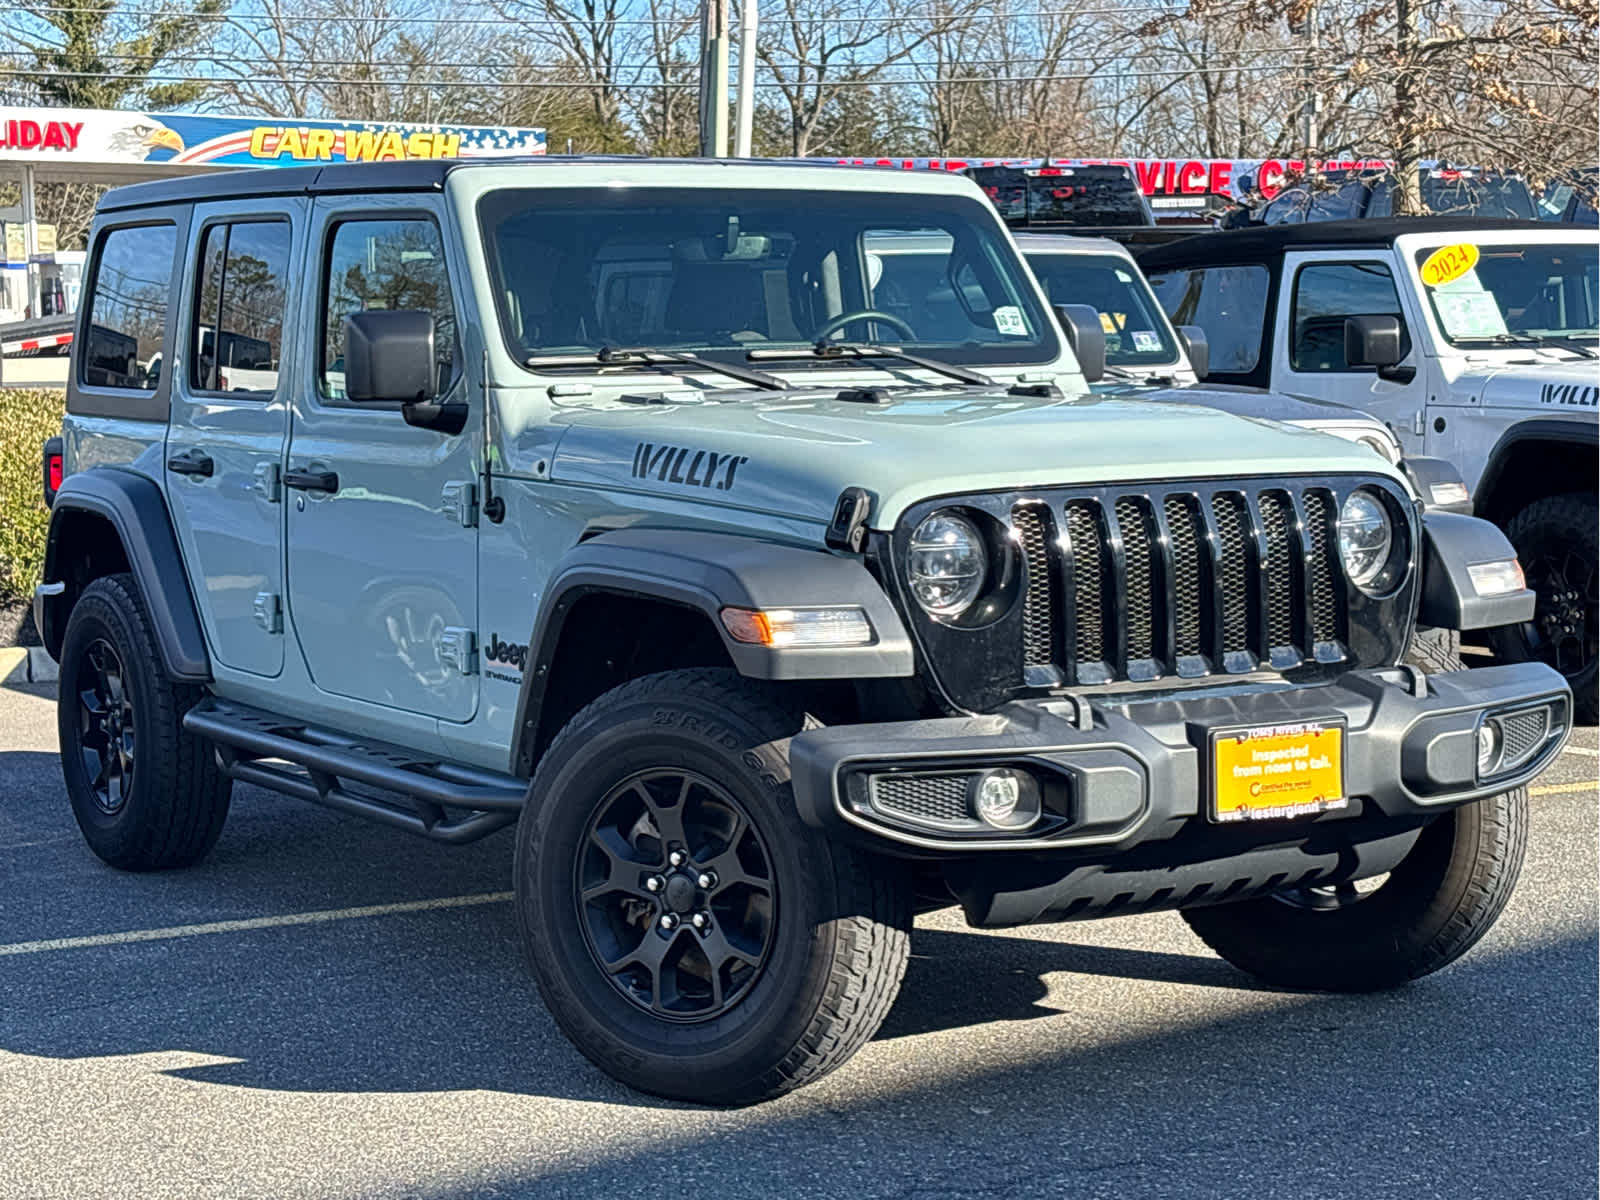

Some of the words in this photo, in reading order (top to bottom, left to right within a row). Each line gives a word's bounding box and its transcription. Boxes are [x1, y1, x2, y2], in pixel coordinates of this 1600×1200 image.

[249, 126, 335, 160] CAR
[344, 129, 461, 162] WASH
[1430, 245, 1469, 283] 2024
[632, 442, 749, 491] WILLYS
[484, 632, 529, 672] Jeep
[1232, 765, 1262, 777] from
[1264, 762, 1292, 774] nose
[1295, 760, 1308, 771] to
[1310, 754, 1331, 769] tail.
[1252, 744, 1309, 762] Inspected
